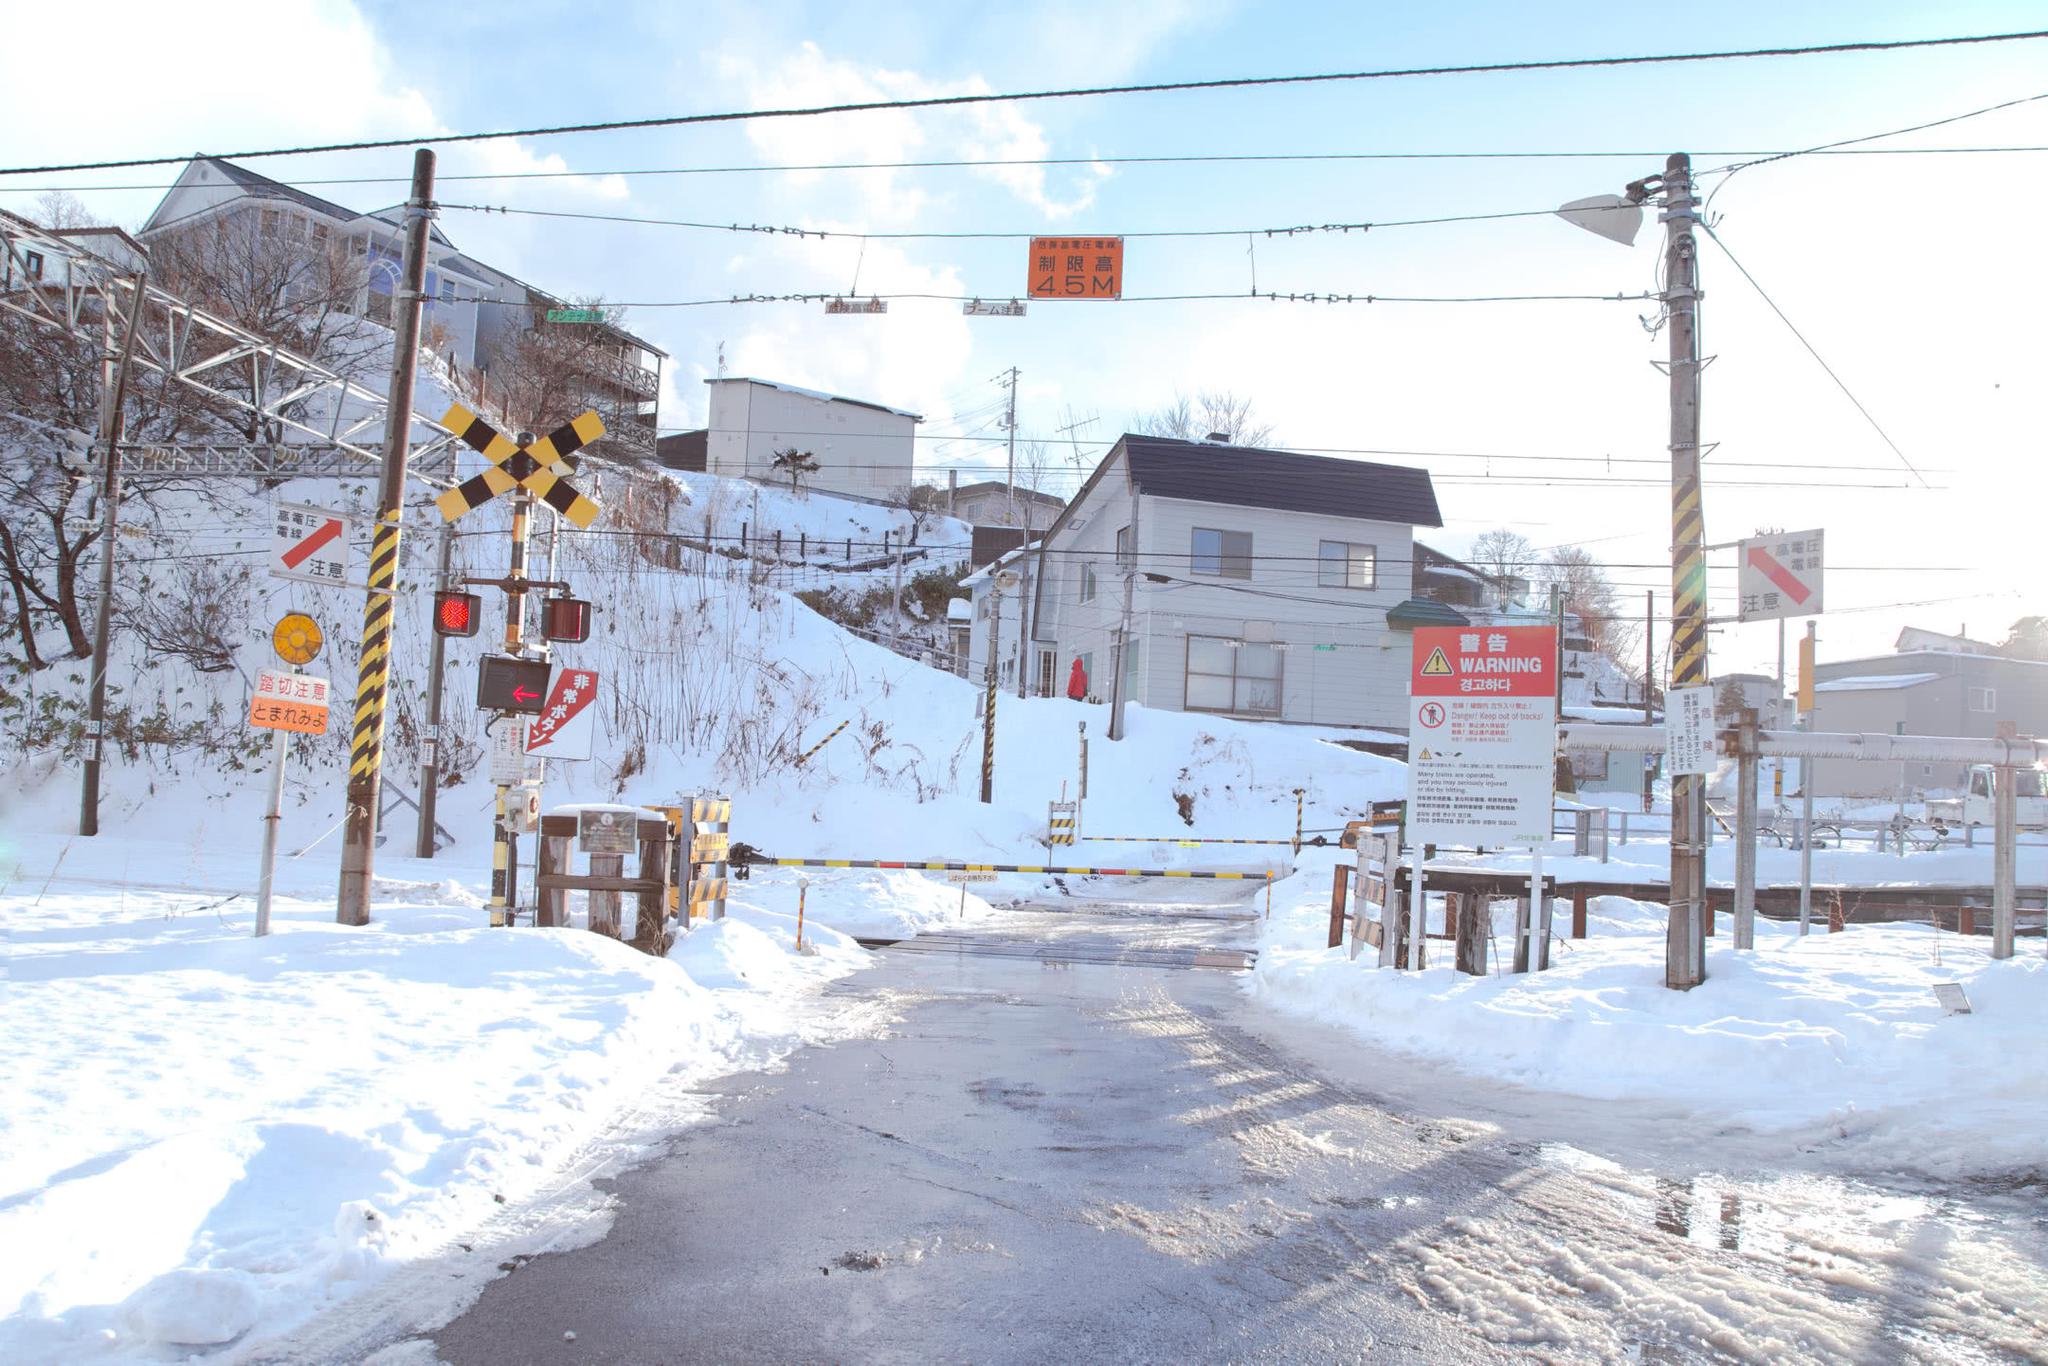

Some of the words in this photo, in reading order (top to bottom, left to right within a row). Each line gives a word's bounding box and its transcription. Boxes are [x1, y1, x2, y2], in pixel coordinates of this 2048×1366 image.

[1039, 255, 1113, 273] 制限高
[277, 510, 318, 528] 高電圧
[277, 525, 303, 538] 電線
[309, 558, 344, 578] 注意
[1742, 592, 1781, 613] 注意
[1459, 634, 1509, 653] 警告
[1459, 657, 1542, 673] WARNING
[258, 674, 328, 701] 踏切注意
[1460, 678, 1512, 692] 경고하다
[253, 704, 326, 728] とまれみよ
[532, 673, 591, 744] 非常ボタン
[1498, 713, 1510, 721] out
[1512, 712, 1519, 720] of
[1417, 771, 1434, 779] Many
[1485, 780, 1508, 788] injured
